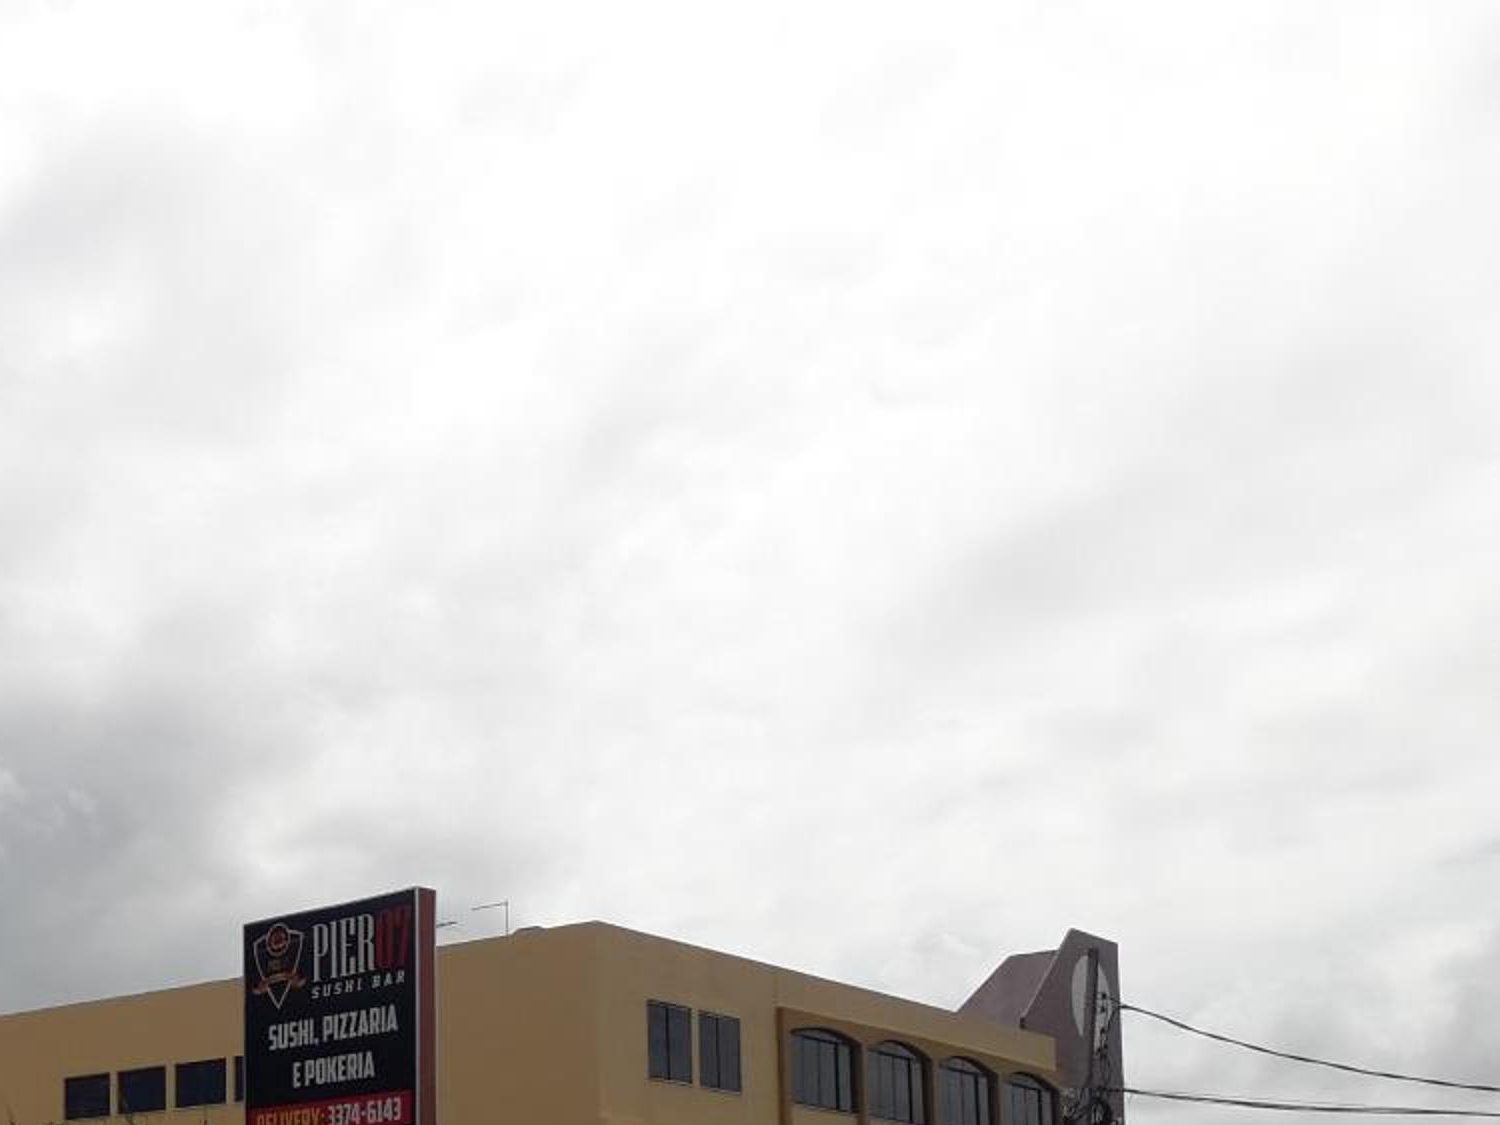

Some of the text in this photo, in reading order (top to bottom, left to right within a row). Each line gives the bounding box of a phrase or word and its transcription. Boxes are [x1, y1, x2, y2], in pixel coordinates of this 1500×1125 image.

[312, 908, 408, 983] PIER07
[311, 978, 362, 999] SUSHI
[372, 969, 405, 988] BAR
[268, 1004, 399, 1051] SUSHI, PIZZARIA
[293, 1051, 376, 1088] E POKERIA
